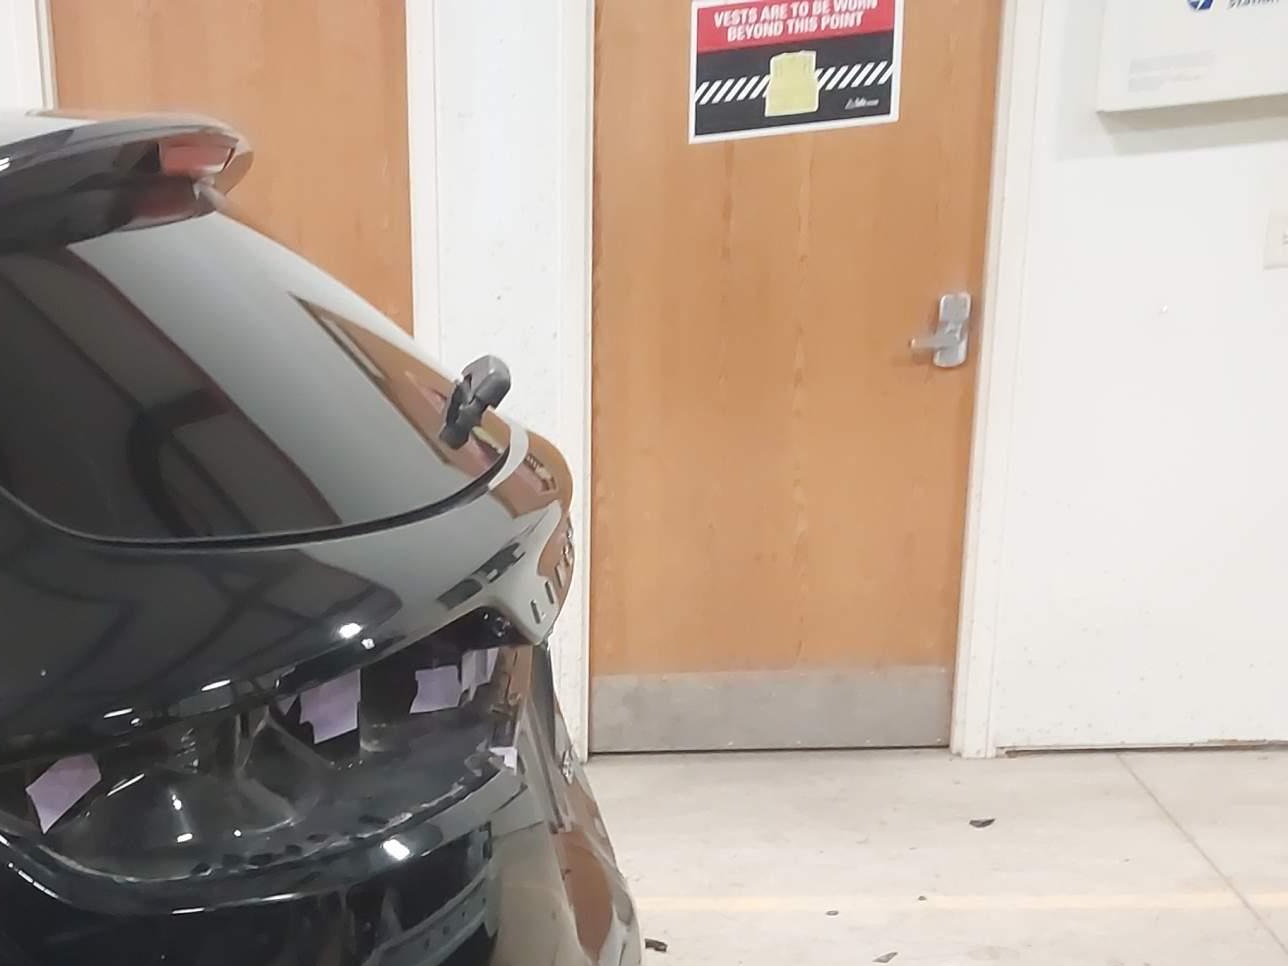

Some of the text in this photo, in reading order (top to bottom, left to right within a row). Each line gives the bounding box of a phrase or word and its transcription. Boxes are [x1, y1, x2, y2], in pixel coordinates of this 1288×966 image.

[714, 7, 757, 28] VESTS
[760, 3, 788, 22] ARE
[790, 0, 810, 18] TO
[812, 0, 832, 16] BE
[727, 10, 864, 42] BEYOND THIS POINT
